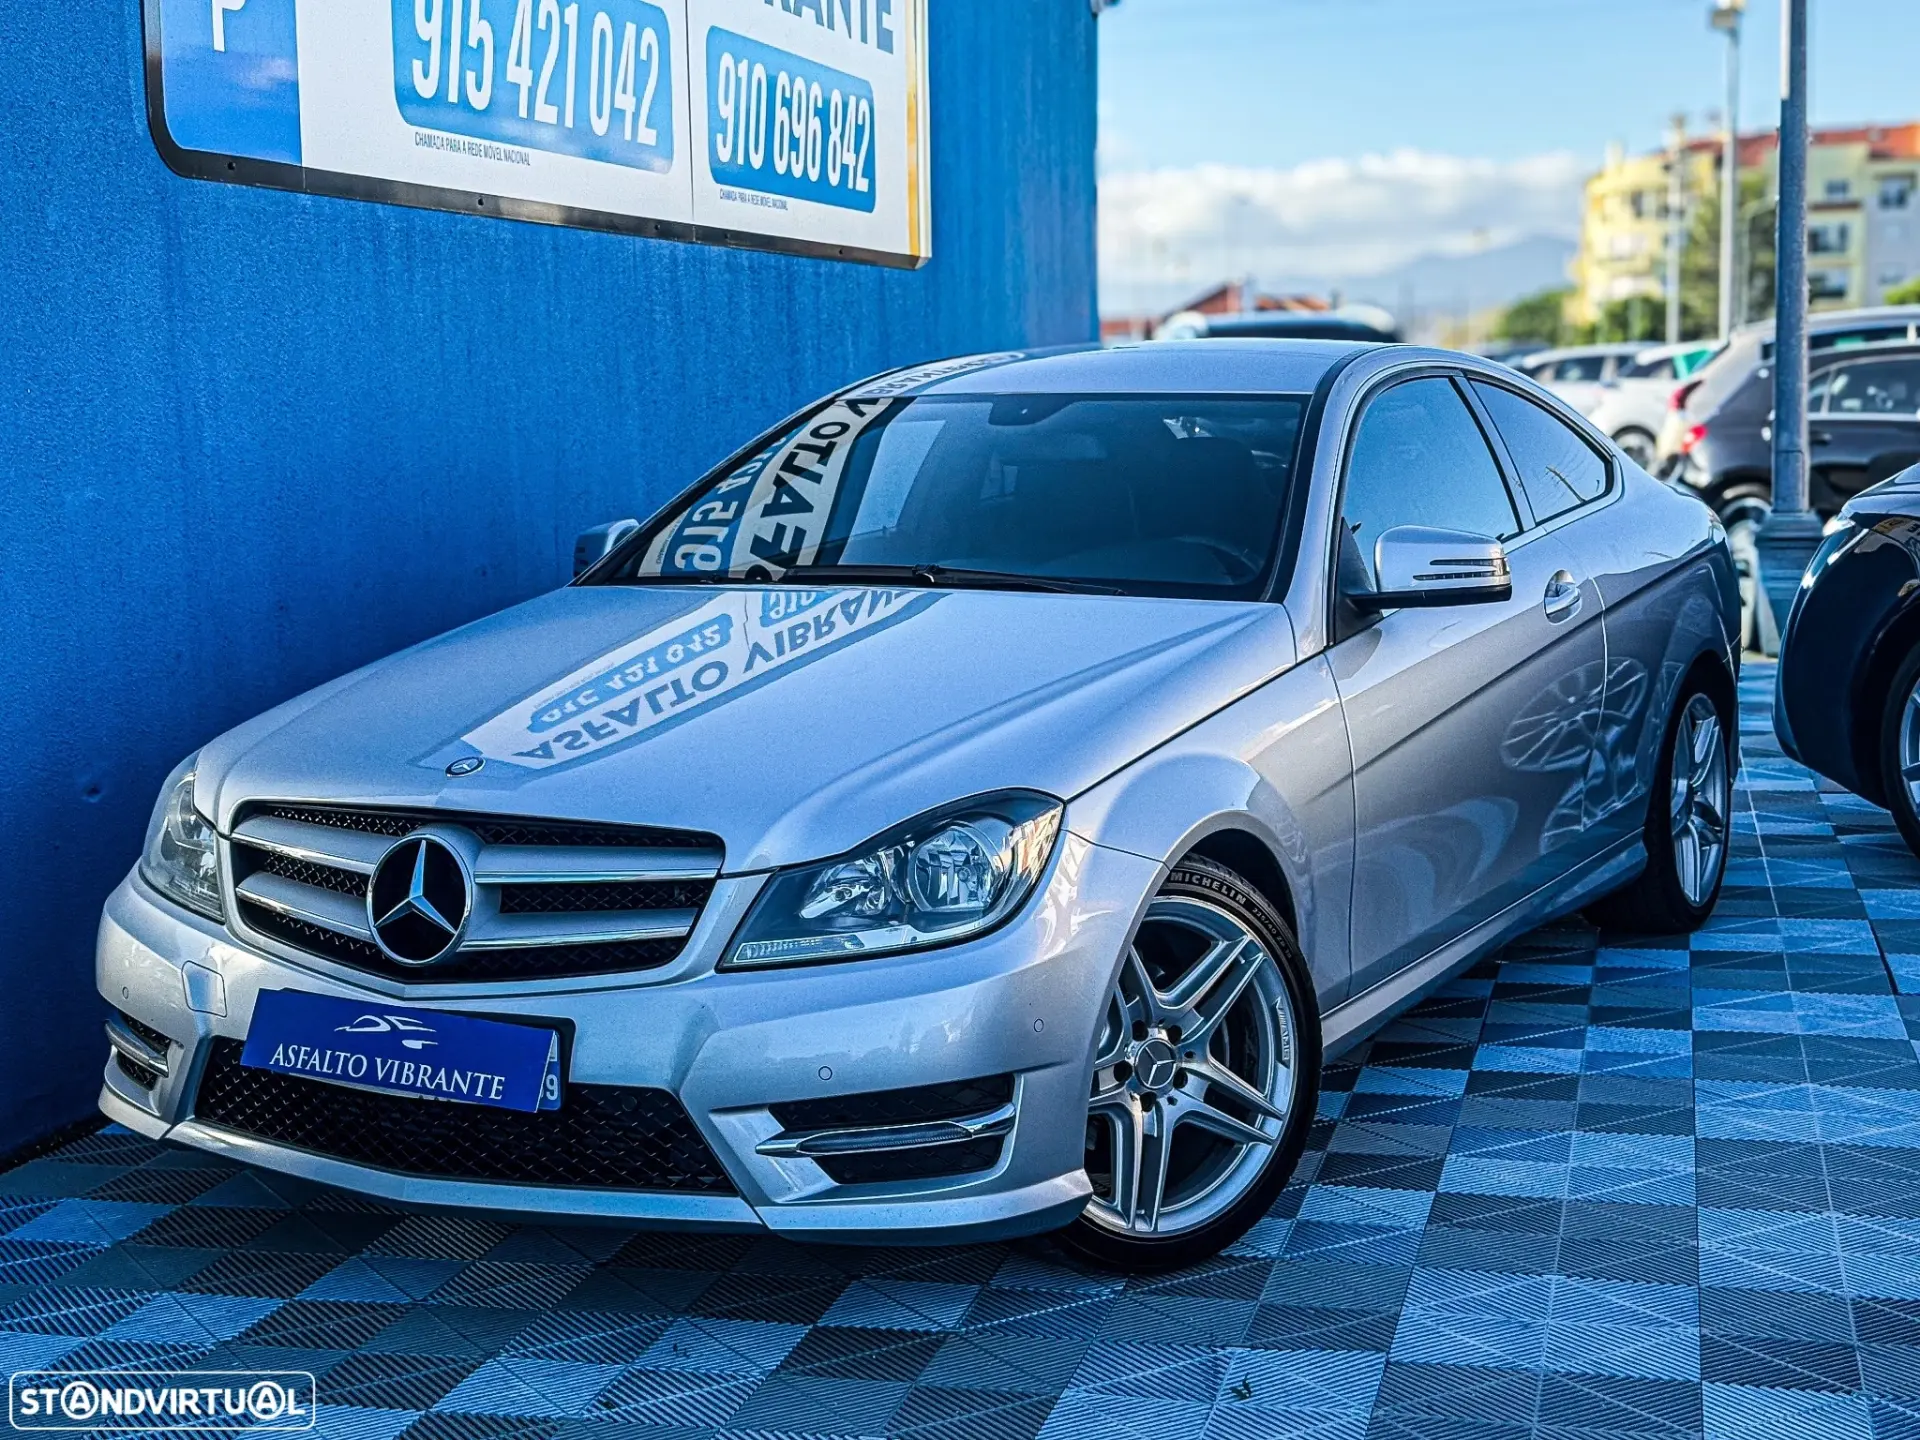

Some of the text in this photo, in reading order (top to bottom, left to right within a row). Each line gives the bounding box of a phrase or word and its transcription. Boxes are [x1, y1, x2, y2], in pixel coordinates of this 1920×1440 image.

[412, 0, 493, 111] 915
[506, 0, 579, 129] 421
[589, 11, 660, 147] 042
[716, 52, 871, 193] 910 696 842
[1170, 871, 1247, 905] MICHELIN
[269, 1043, 506, 1100] ASFALTO VIBRANTE
